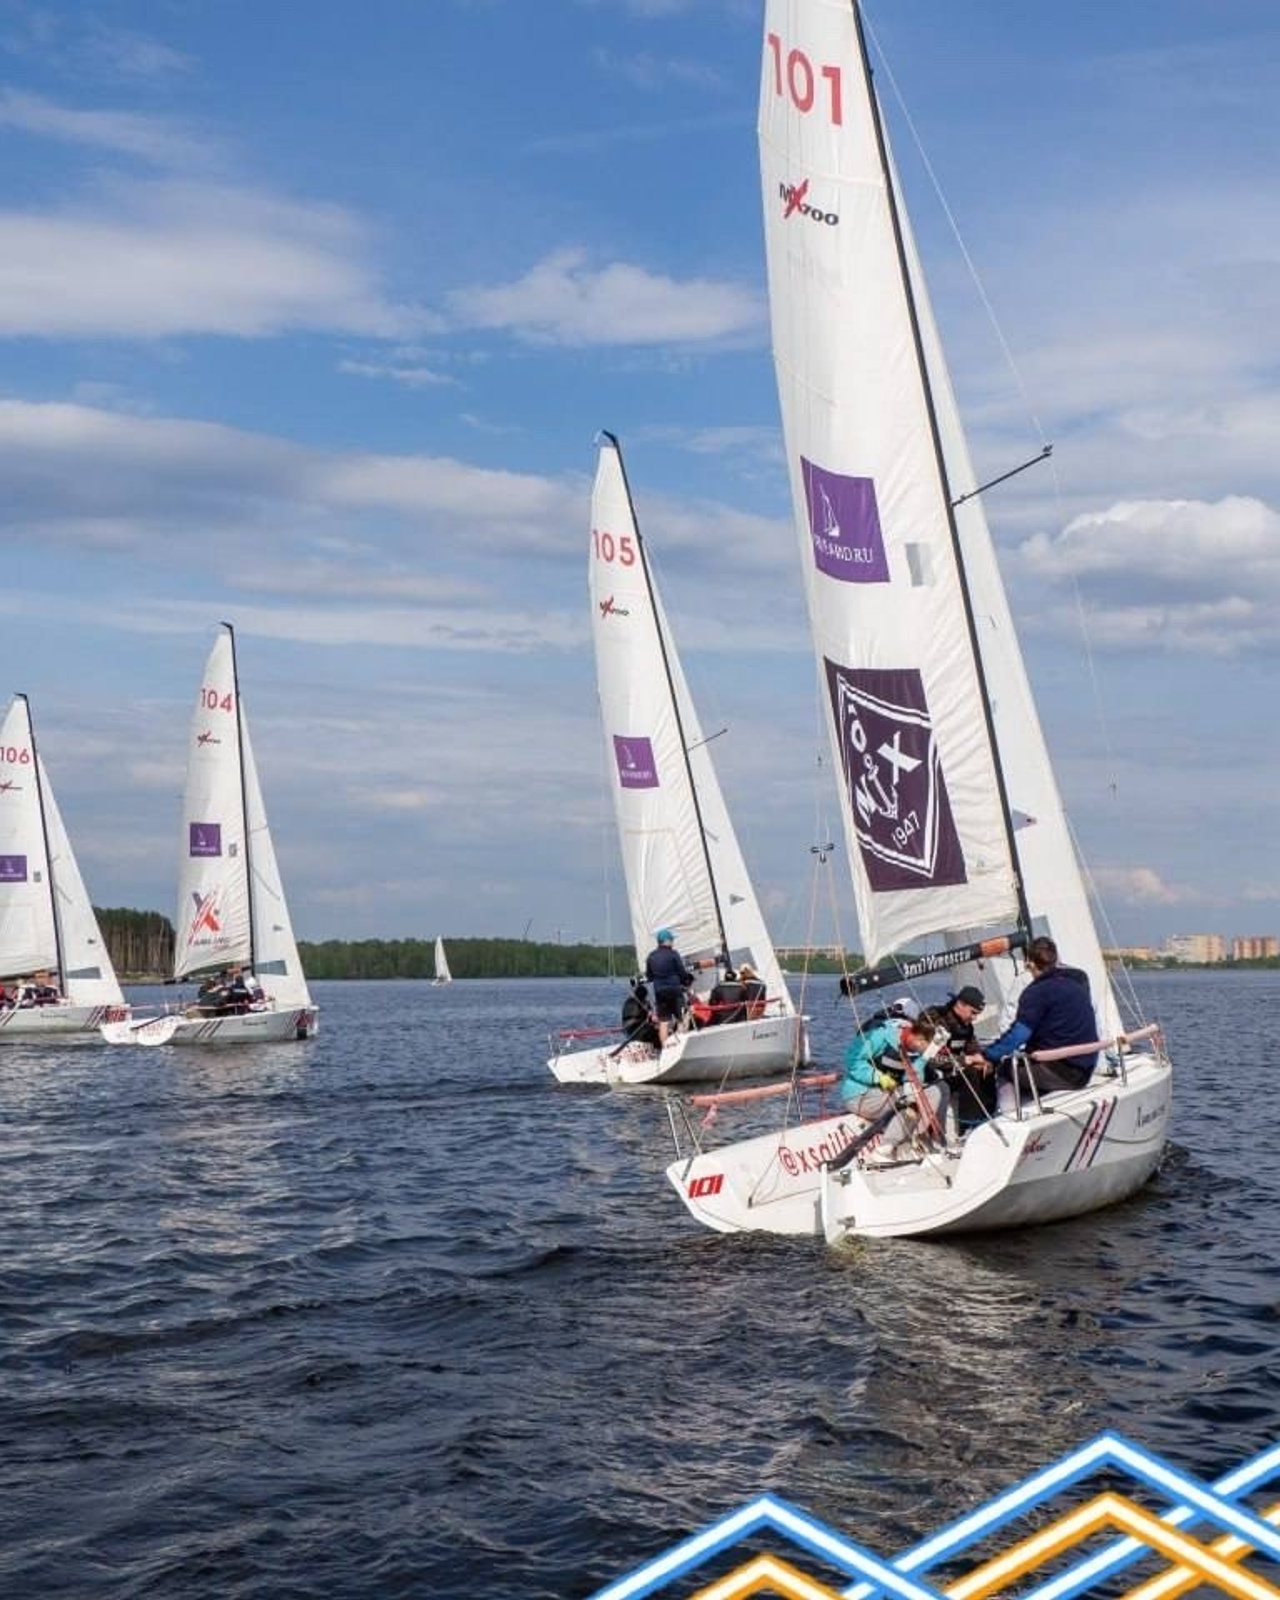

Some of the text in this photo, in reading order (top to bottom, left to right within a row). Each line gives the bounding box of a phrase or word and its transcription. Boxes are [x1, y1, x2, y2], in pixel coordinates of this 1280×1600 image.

[767, 32, 843, 127] 101
[593, 528, 635, 566] 105
[200, 688, 232, 712] 104
[0, 746, 29, 764] 106
[892, 810, 921, 849] 1947
[688, 1173, 724, 1199] 101
